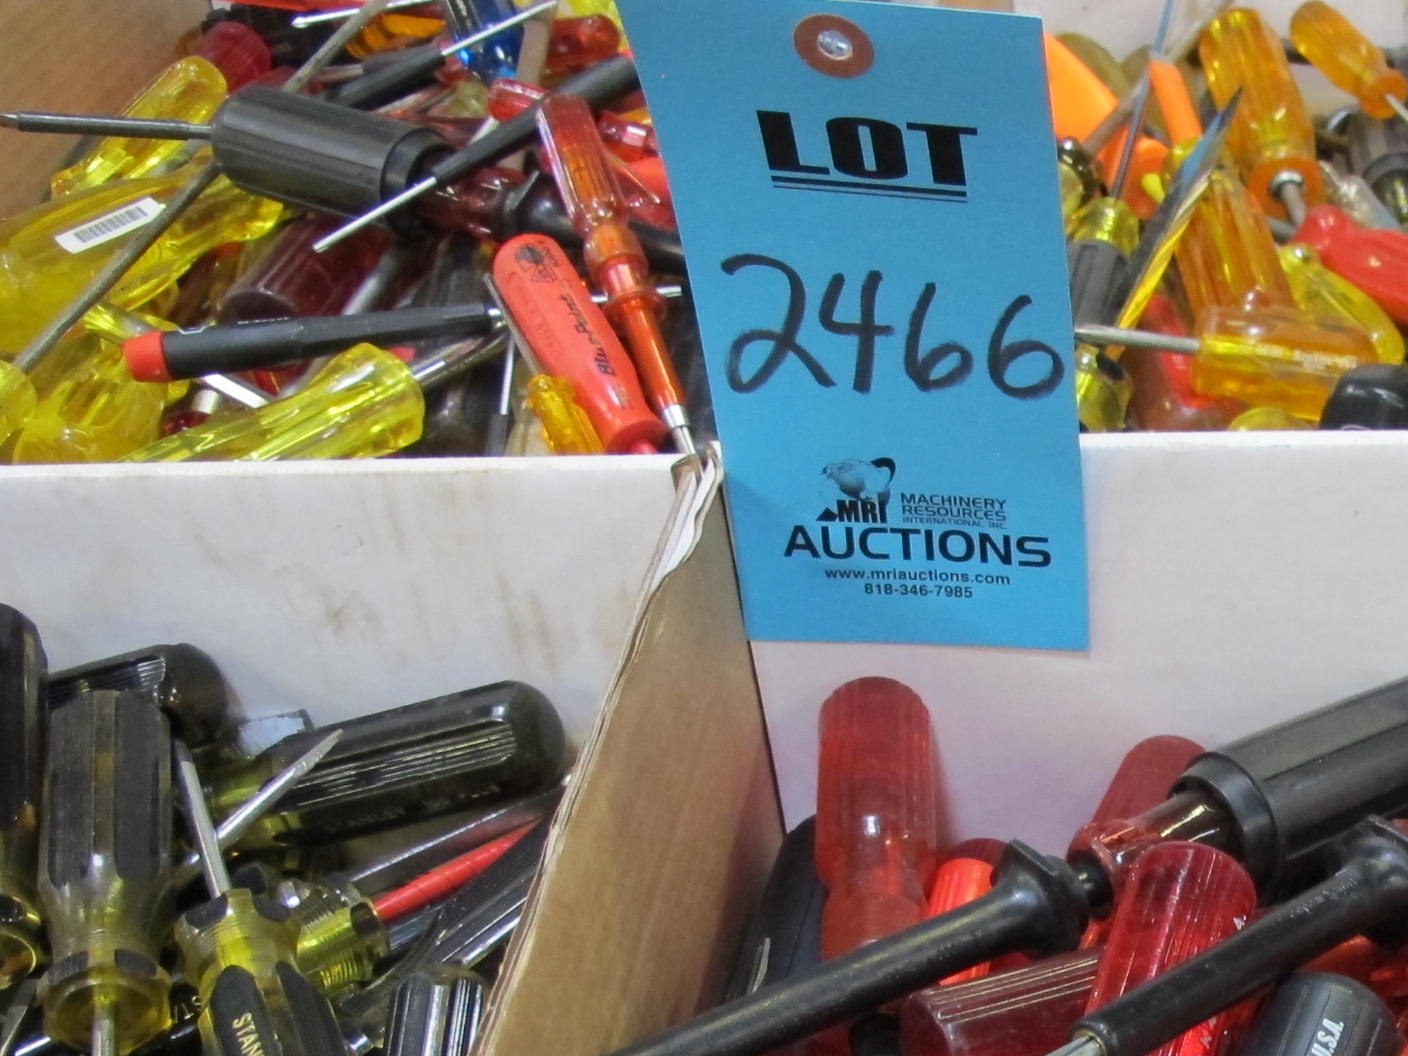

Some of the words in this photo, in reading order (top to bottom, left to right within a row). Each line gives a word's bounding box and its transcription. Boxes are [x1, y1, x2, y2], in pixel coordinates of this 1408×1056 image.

[756, 110, 978, 186] LOT
[720, 253, 1065, 399] 2466
[835, 494, 889, 524] MRI
[900, 492, 1007, 509] MACHINERY
[902, 505, 1007, 521] RESOURCES
[902, 516, 984, 528] INTERNATIONAL
[784, 525, 1052, 568] AUCTIONS
[824, 567, 1011, 585] www.mriauctions.com
[864, 583, 973, 599] 818-346-7985
